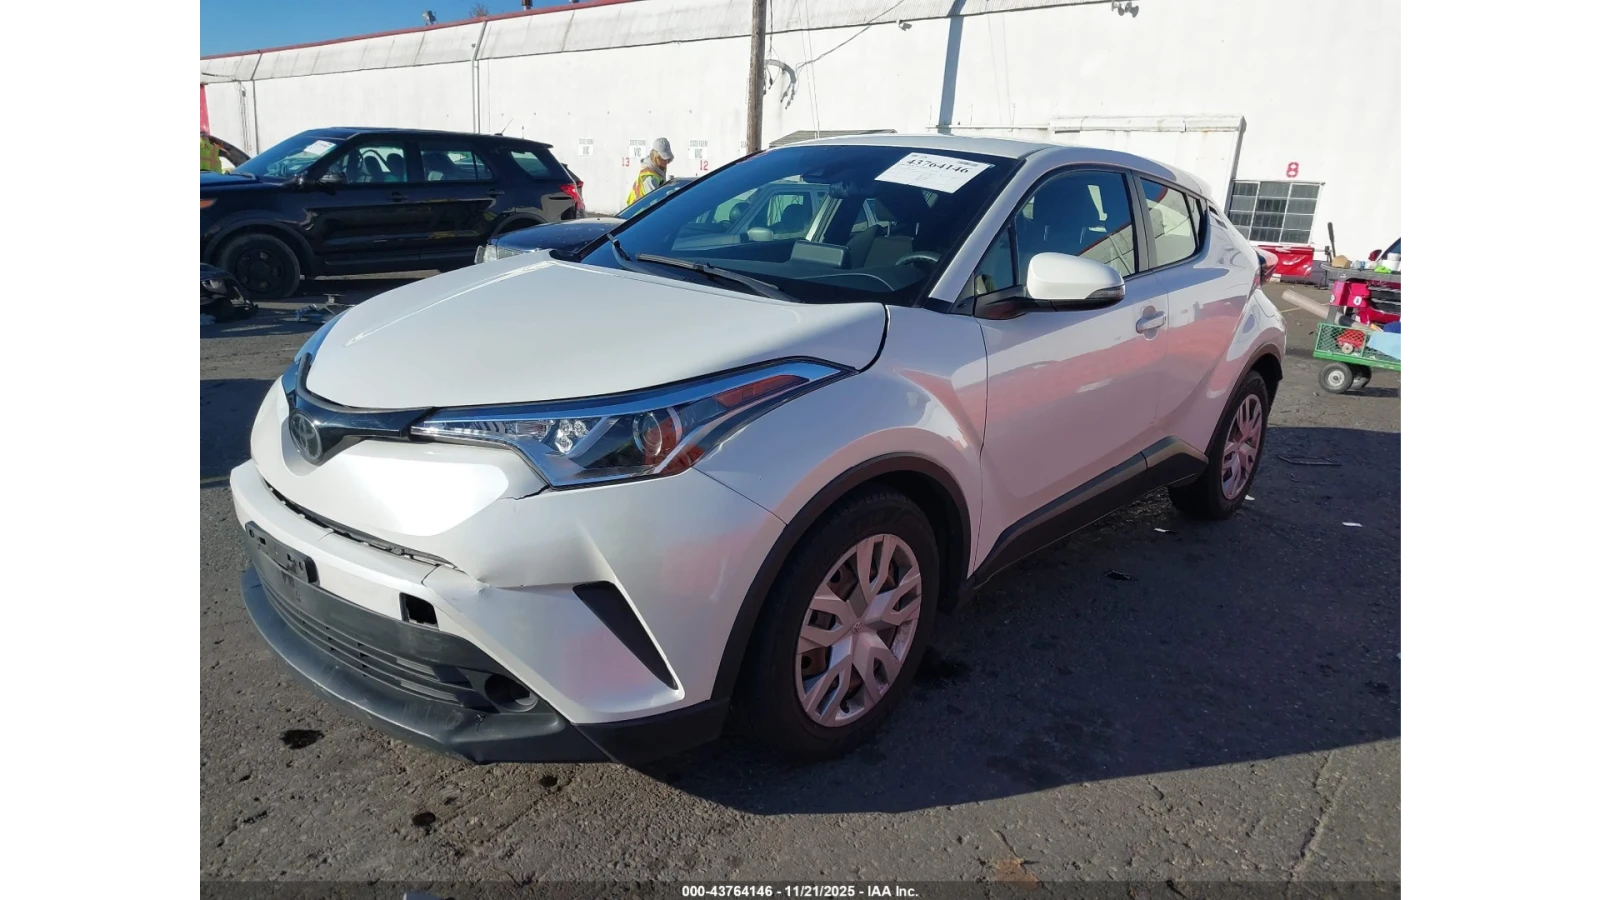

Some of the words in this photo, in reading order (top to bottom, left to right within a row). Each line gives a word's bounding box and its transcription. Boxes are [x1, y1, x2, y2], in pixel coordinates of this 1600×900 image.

[633, 147, 642, 157] VIC
[621, 157, 630, 167] 13
[699, 160, 709, 171] 12
[907, 158, 969, 174] 43764146
[1286, 161, 1299, 178] 8
